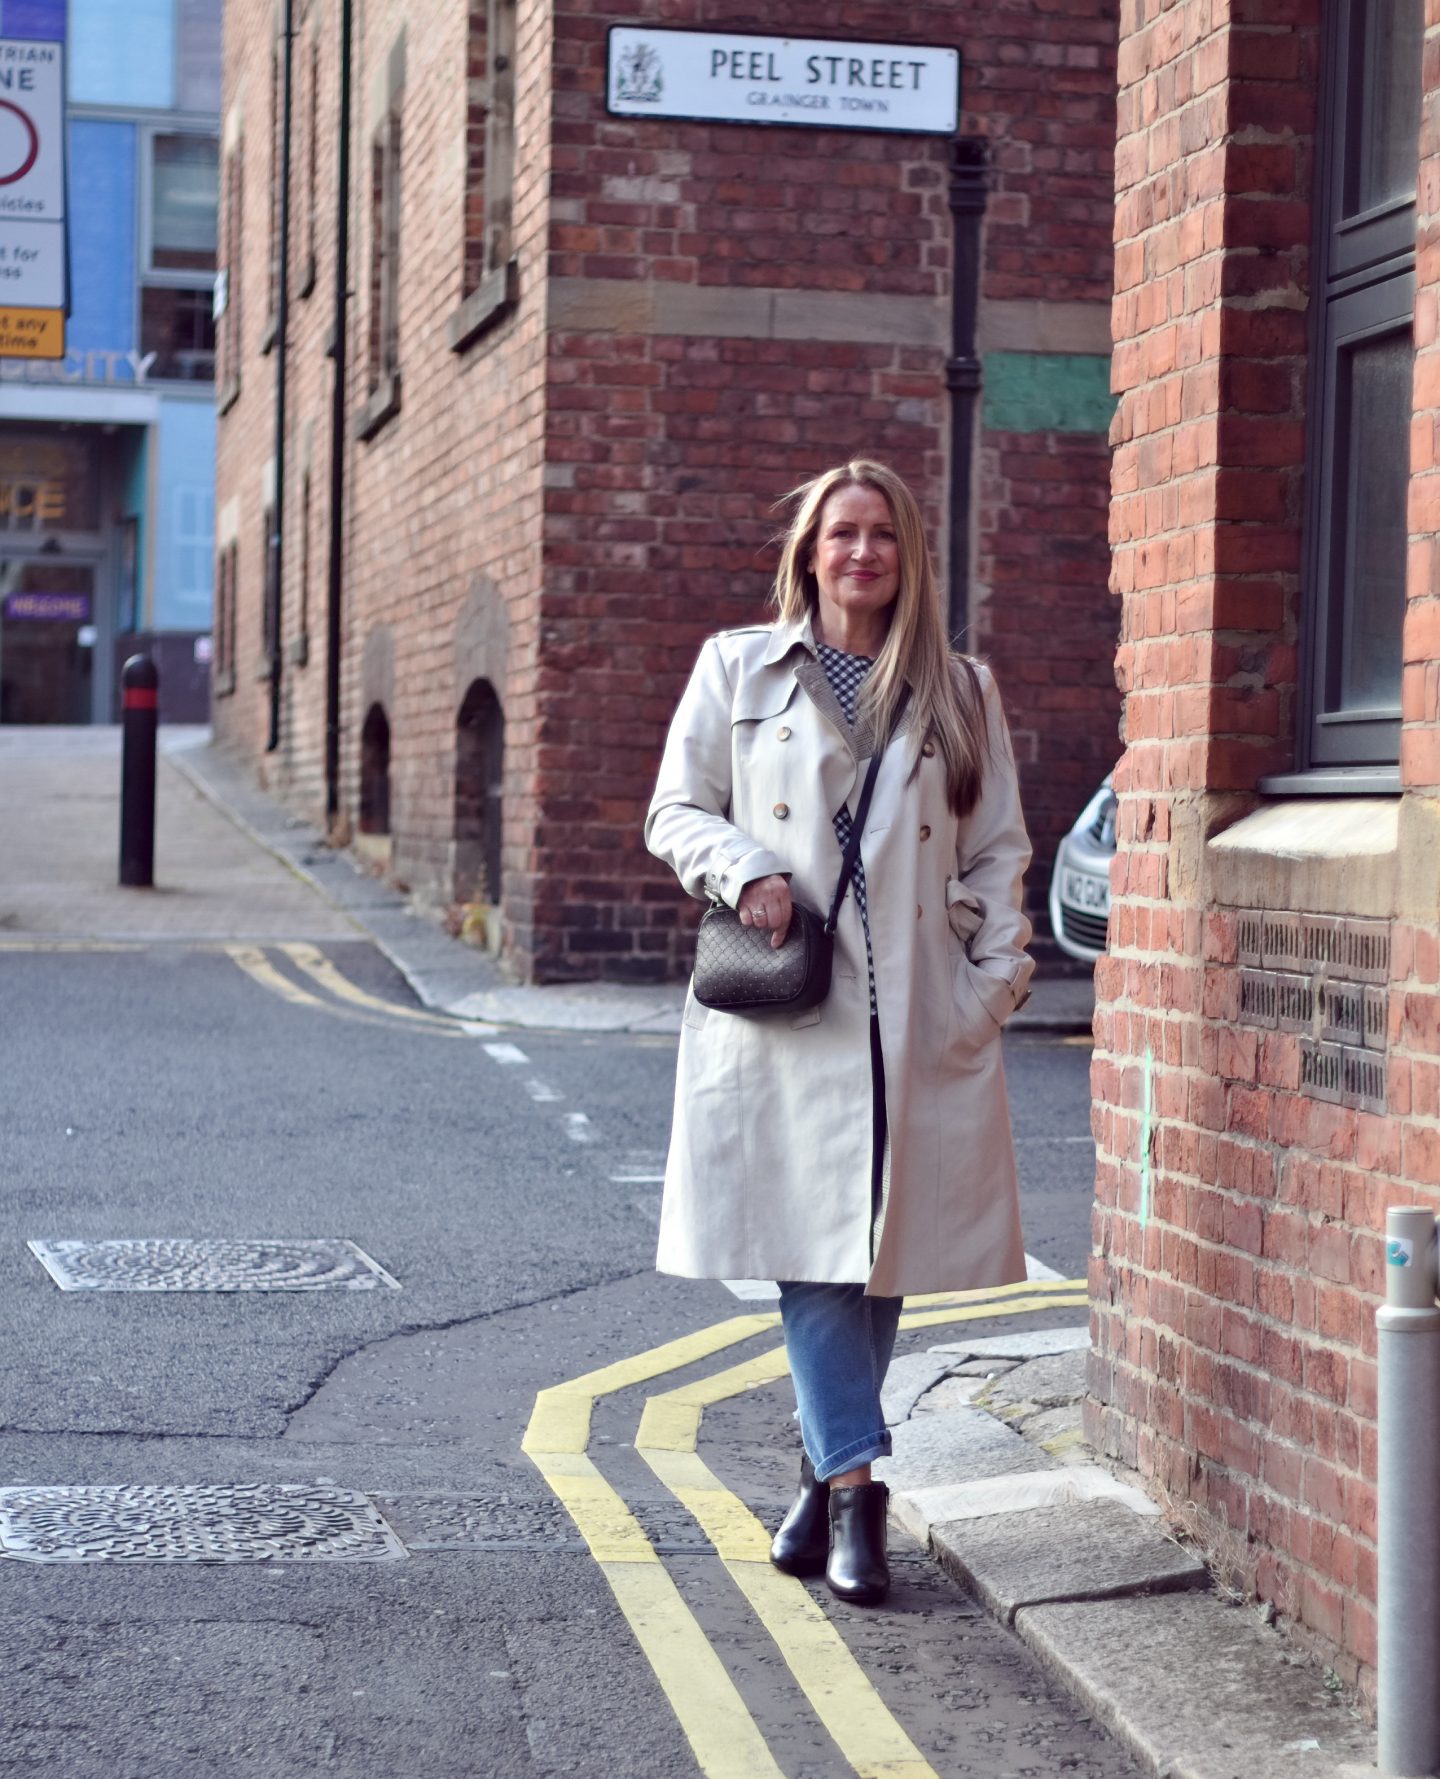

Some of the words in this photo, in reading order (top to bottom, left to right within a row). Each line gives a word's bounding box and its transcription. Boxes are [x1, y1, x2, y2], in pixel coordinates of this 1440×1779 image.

[710, 49, 782, 82] PEEL
[807, 56, 926, 90] STREET
[746, 91, 830, 109] GRAINGER
[840, 96, 888, 112] TOWN
[13, 246, 39, 261] for
[16, 319, 47, 333] any
[55, 347, 158, 386] CITY
